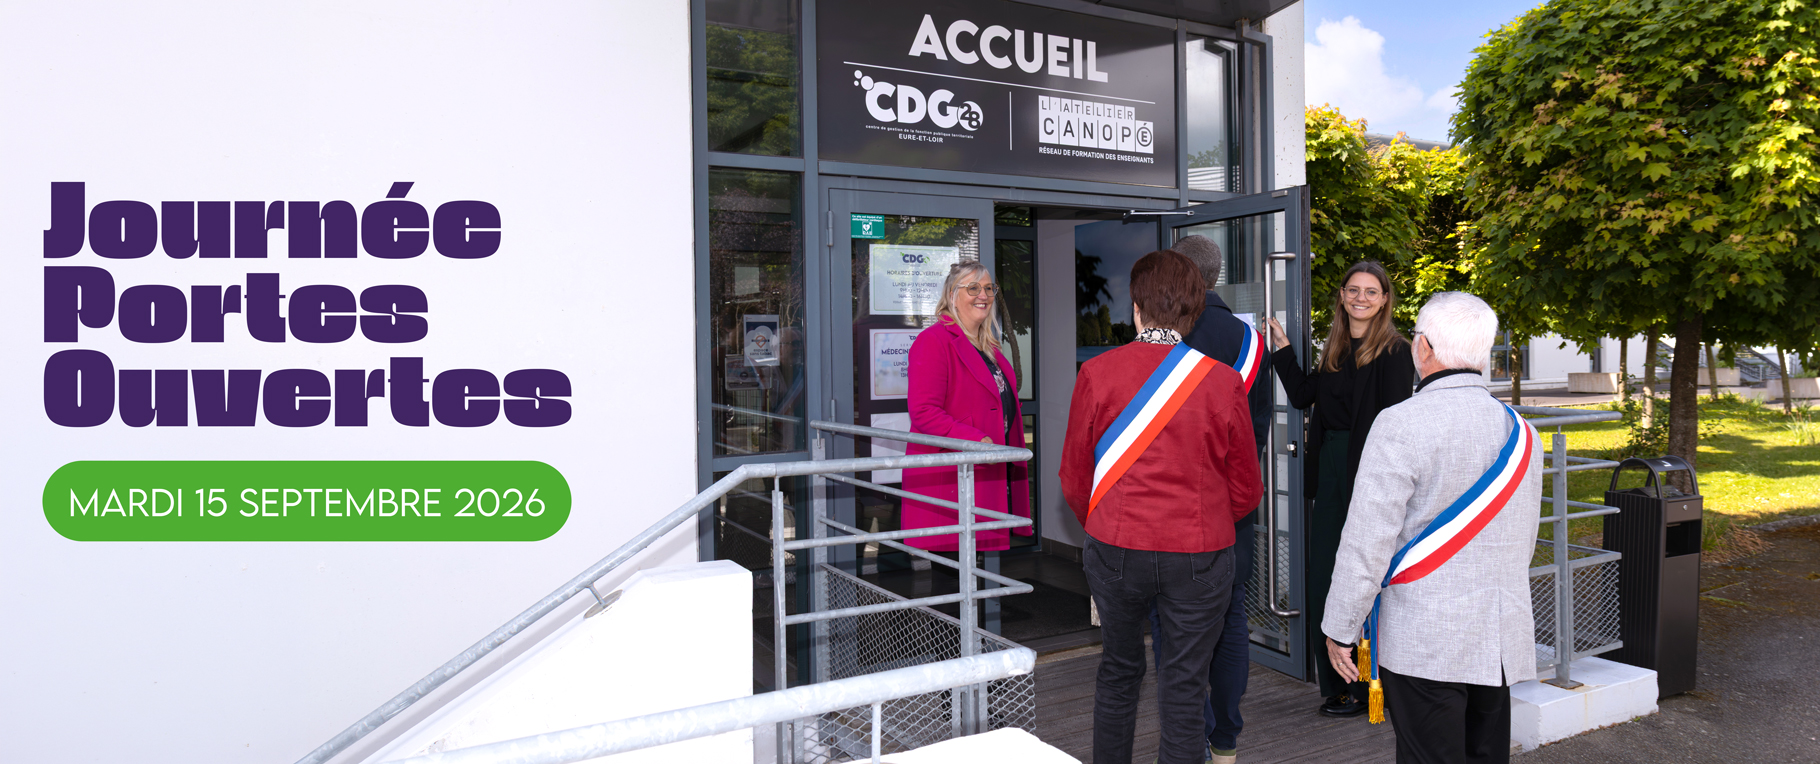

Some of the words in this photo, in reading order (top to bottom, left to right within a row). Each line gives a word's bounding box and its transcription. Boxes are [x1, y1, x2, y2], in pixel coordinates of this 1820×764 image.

[908, 13, 1109, 83] ACCUEIL
[1041, 99, 1134, 121] L'ATELIER
[898, 133, 944, 143] EURE-ET-LOIR
[1043, 117, 1153, 147] CANOPÉ
[1039, 146, 1062, 155] RÉSEAU
[1072, 150, 1104, 159] FORMATION
[1117, 154, 1154, 164] ENSEIGNANTS
